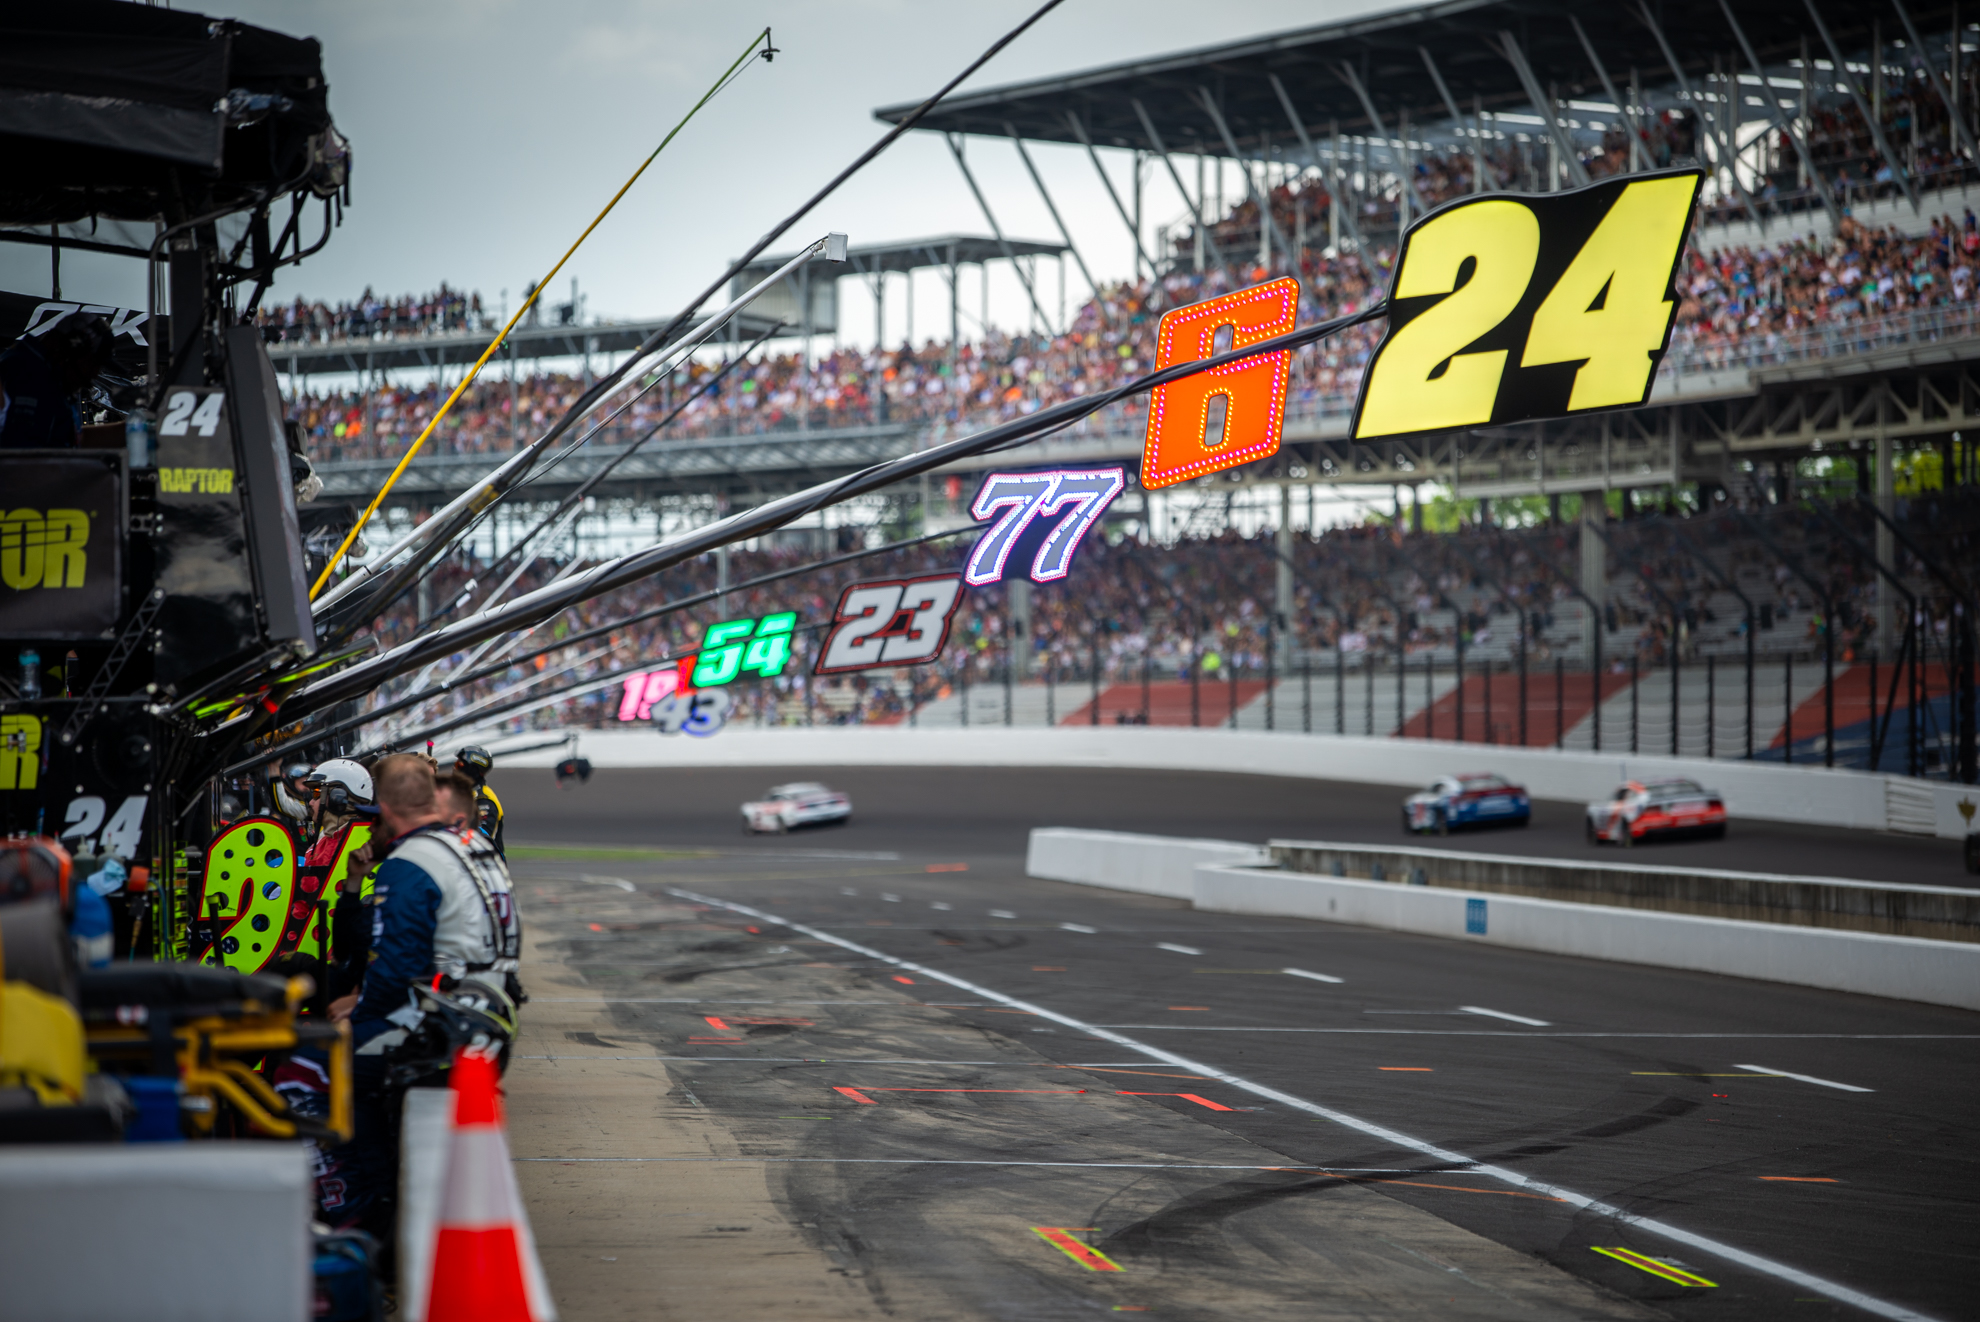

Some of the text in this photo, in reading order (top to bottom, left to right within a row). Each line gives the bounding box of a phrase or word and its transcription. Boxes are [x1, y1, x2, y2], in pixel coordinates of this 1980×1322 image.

[1355, 173, 1699, 439] 24
[159, 391, 225, 437] 24
[1141, 276, 1300, 491] 6
[158, 467, 235, 494] RAPTOR
[0, 507, 90, 591] OR
[964, 467, 1125, 587] 77
[692, 611, 797, 688] 54
[822, 577, 965, 670] 23
[651, 687, 730, 738] 43
[61, 794, 149, 860] 24
